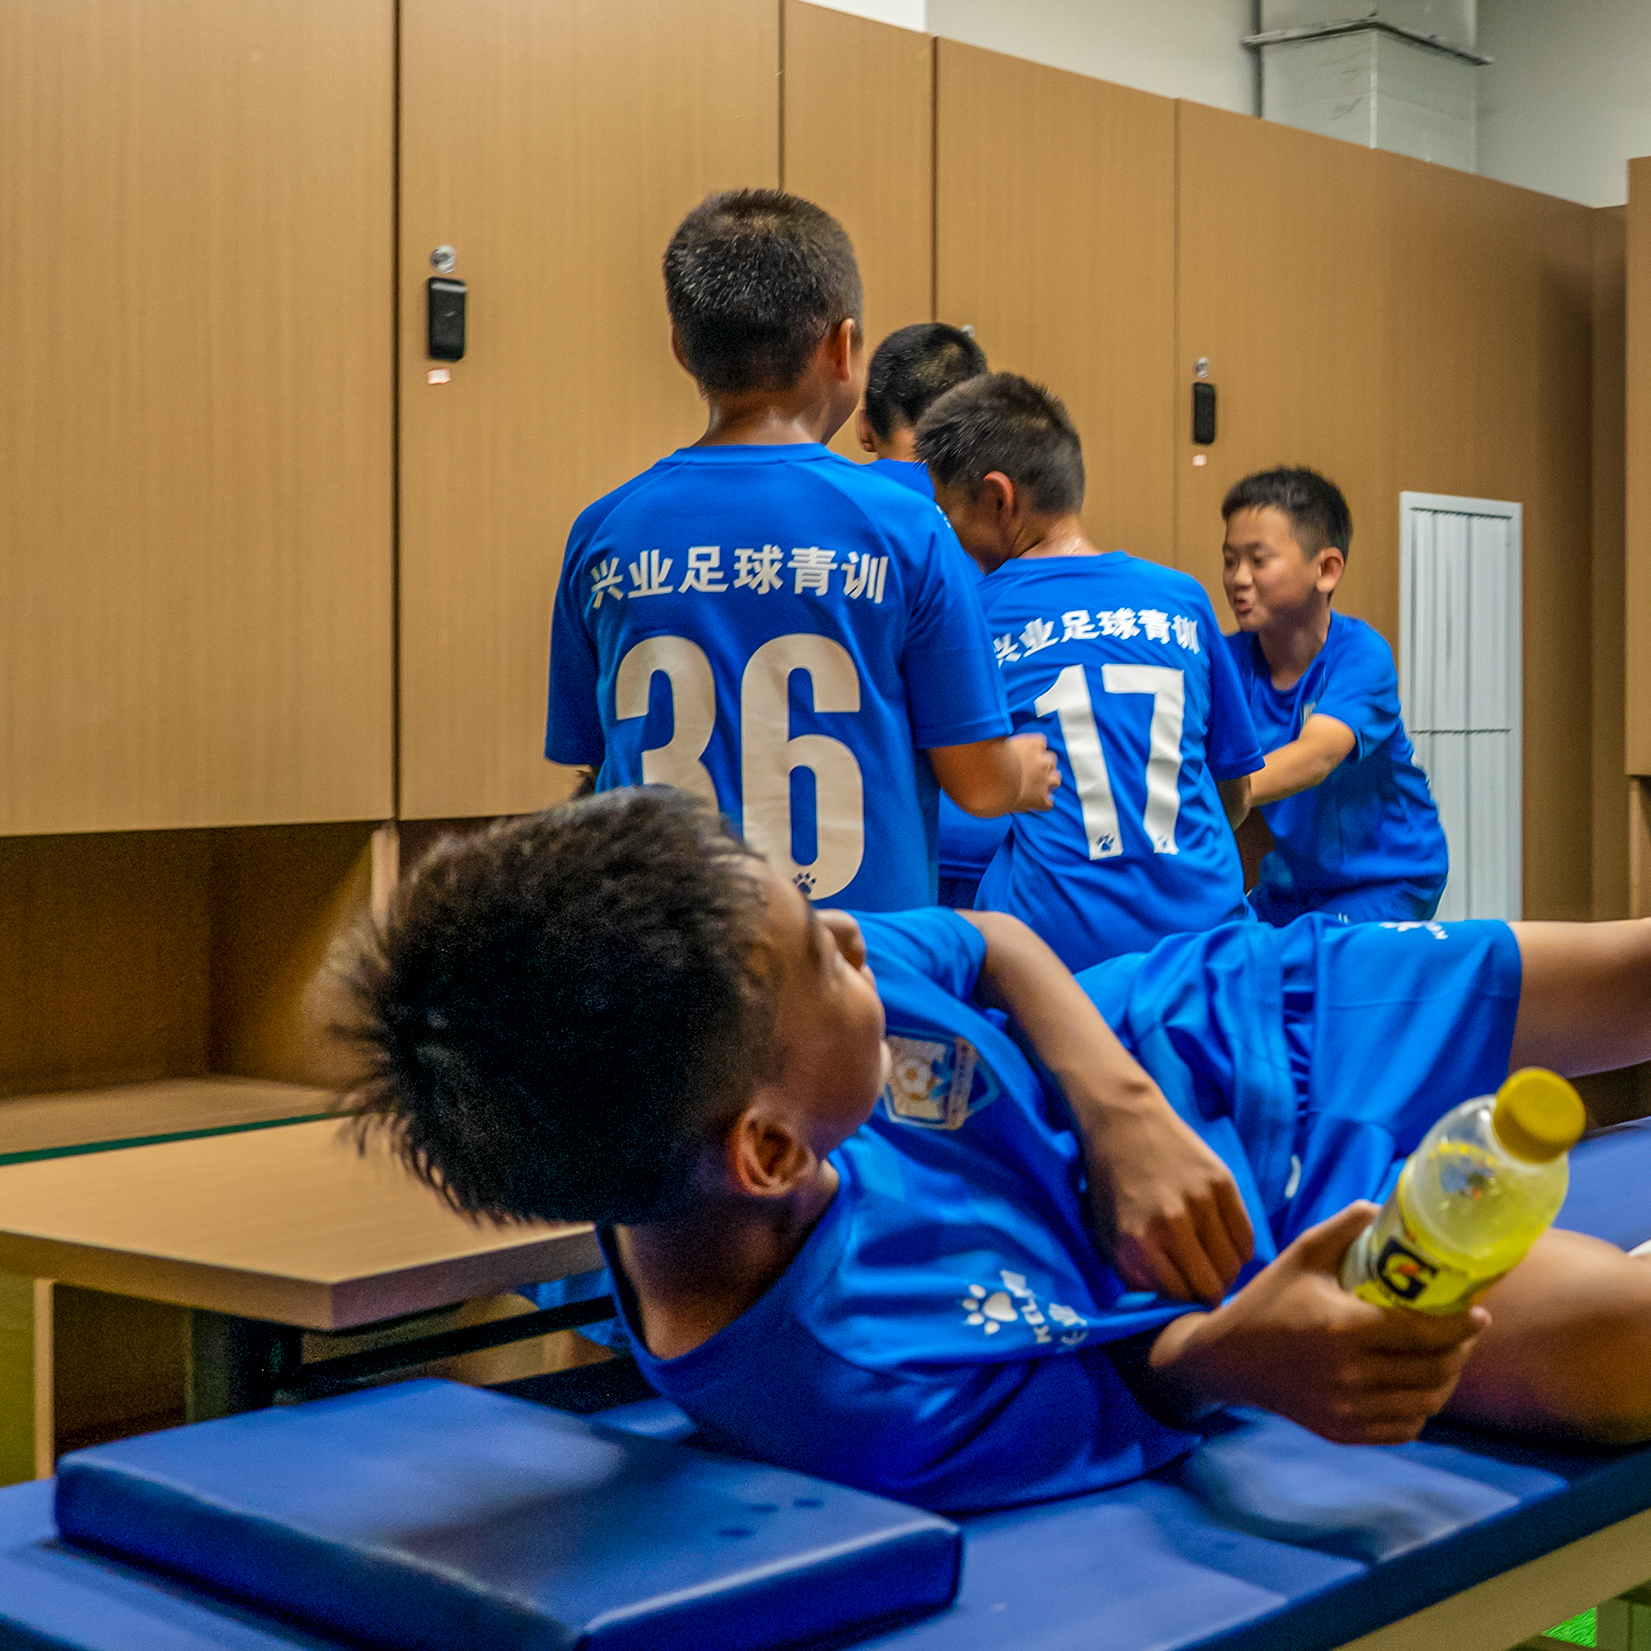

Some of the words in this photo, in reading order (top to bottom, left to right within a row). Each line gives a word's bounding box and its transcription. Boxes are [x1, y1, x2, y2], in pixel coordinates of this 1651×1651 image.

[590, 544, 889, 609] 兴业足球青训
[993, 607, 1200, 668] 兴业足球青训
[615, 632, 865, 900] 36
[1034, 663, 1184, 861] 17
